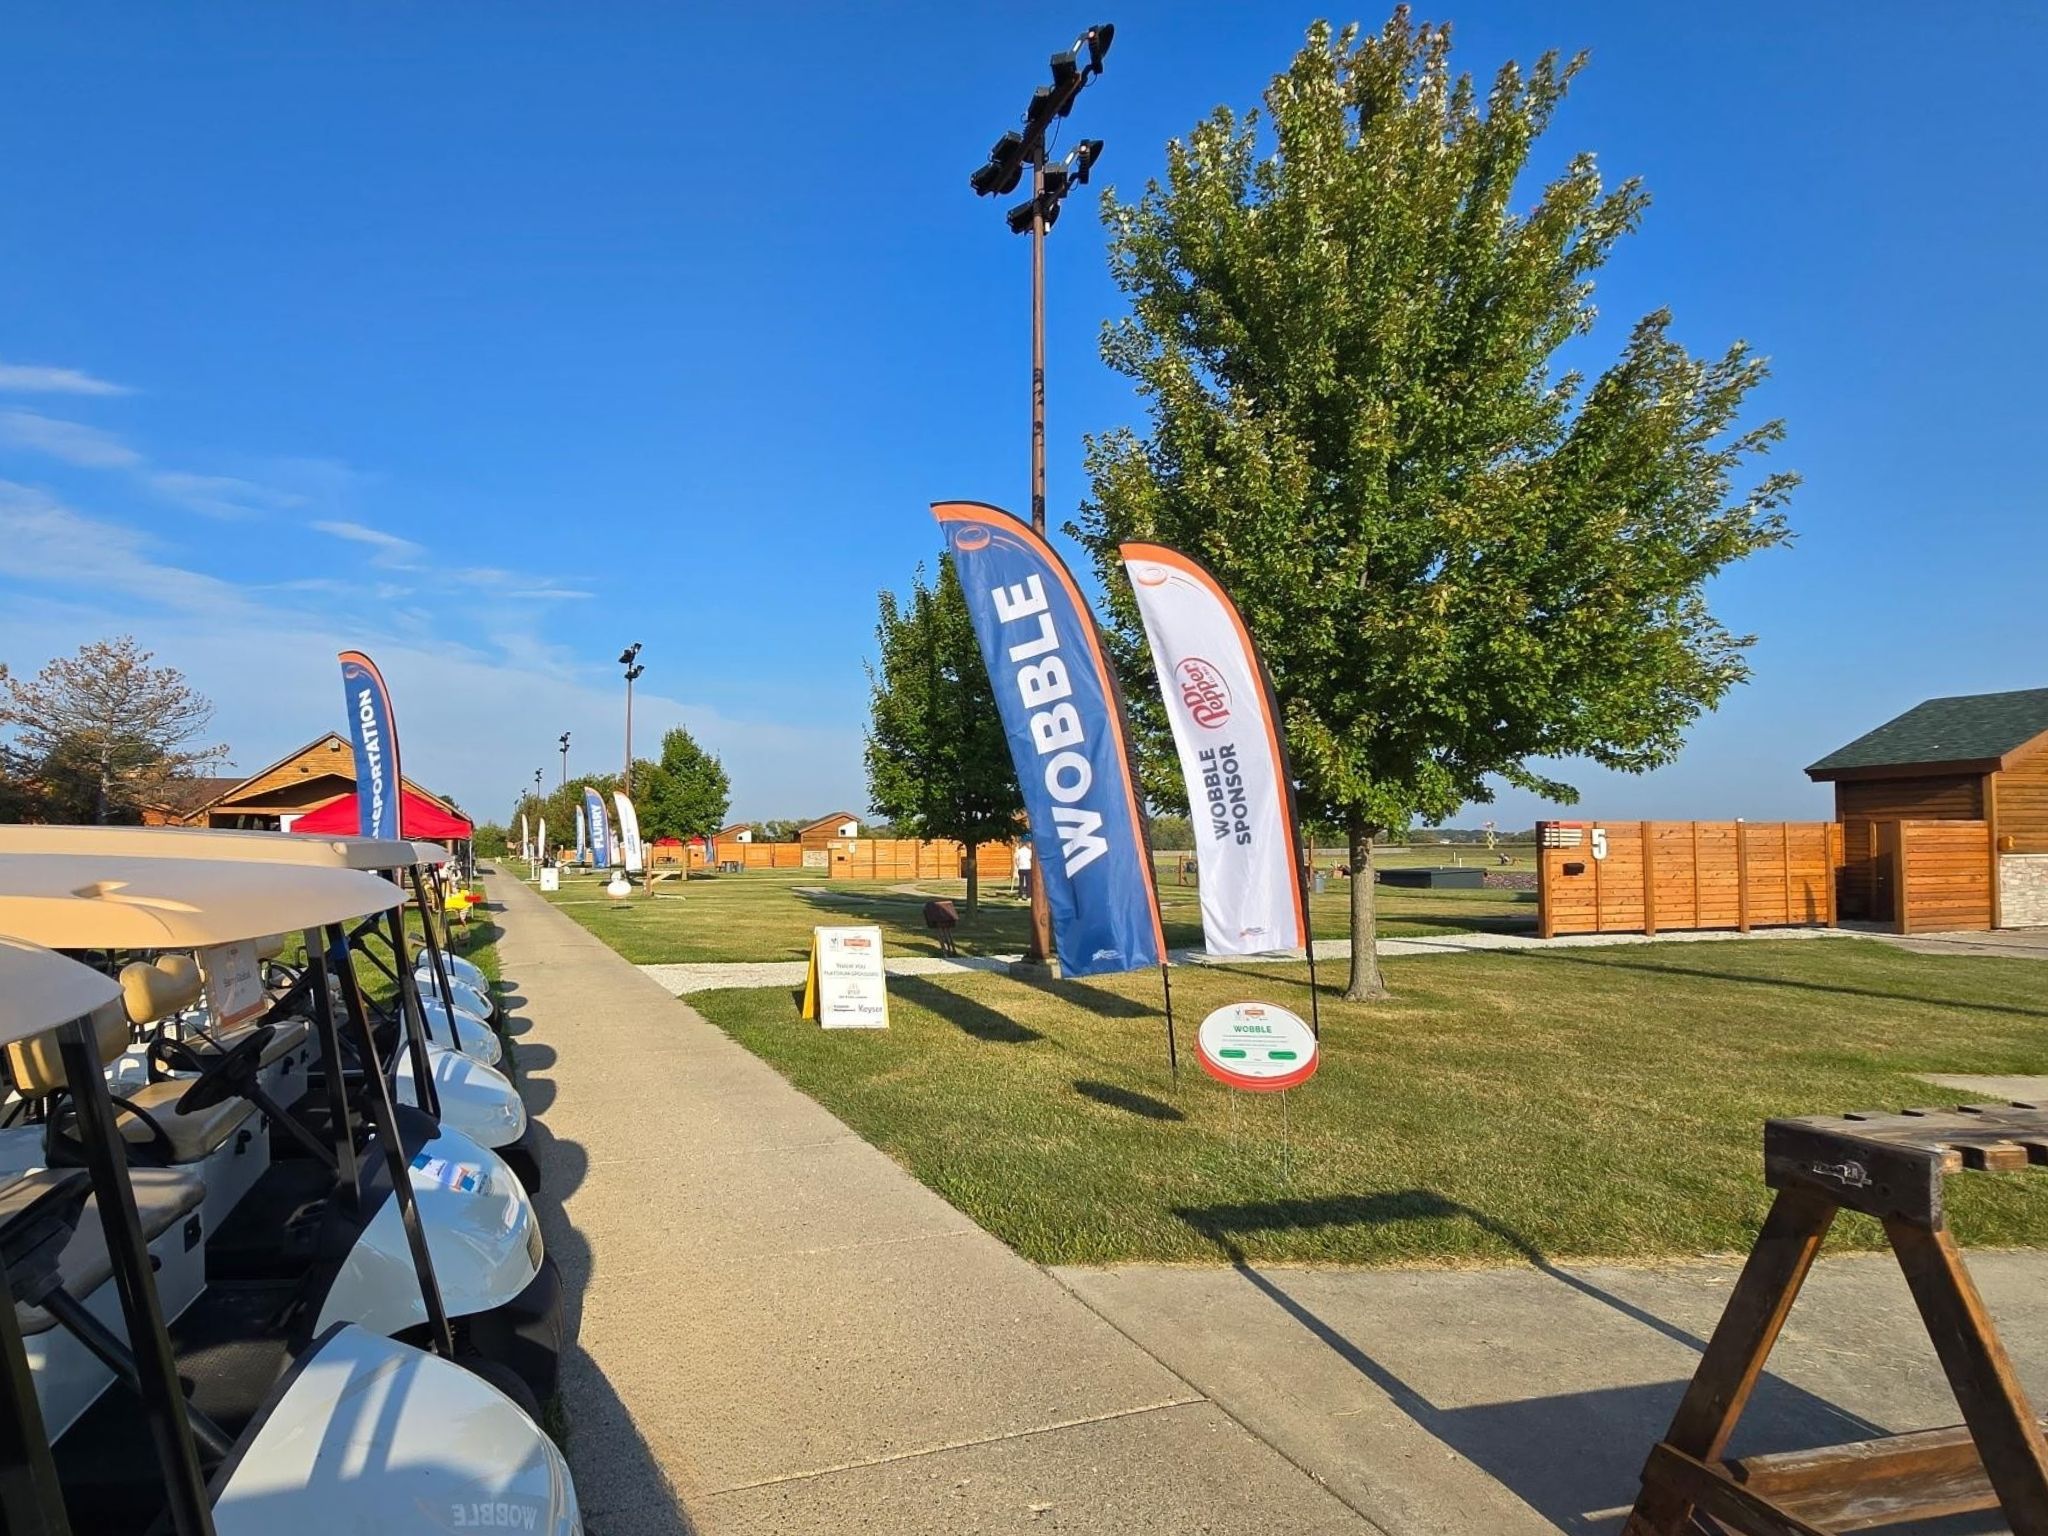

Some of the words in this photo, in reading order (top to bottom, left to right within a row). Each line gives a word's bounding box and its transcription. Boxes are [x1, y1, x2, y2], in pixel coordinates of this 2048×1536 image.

[991, 573, 1109, 879] WOBBLE
[1184, 662, 1232, 730] Pepper
[591, 805, 604, 848] FLURRY
[1199, 748, 1231, 841] WOBBLE
[1219, 743, 1252, 845] SPONSOR
[1591, 828, 1607, 860] 5
[1234, 1025, 1272, 1033] WOBBLE
